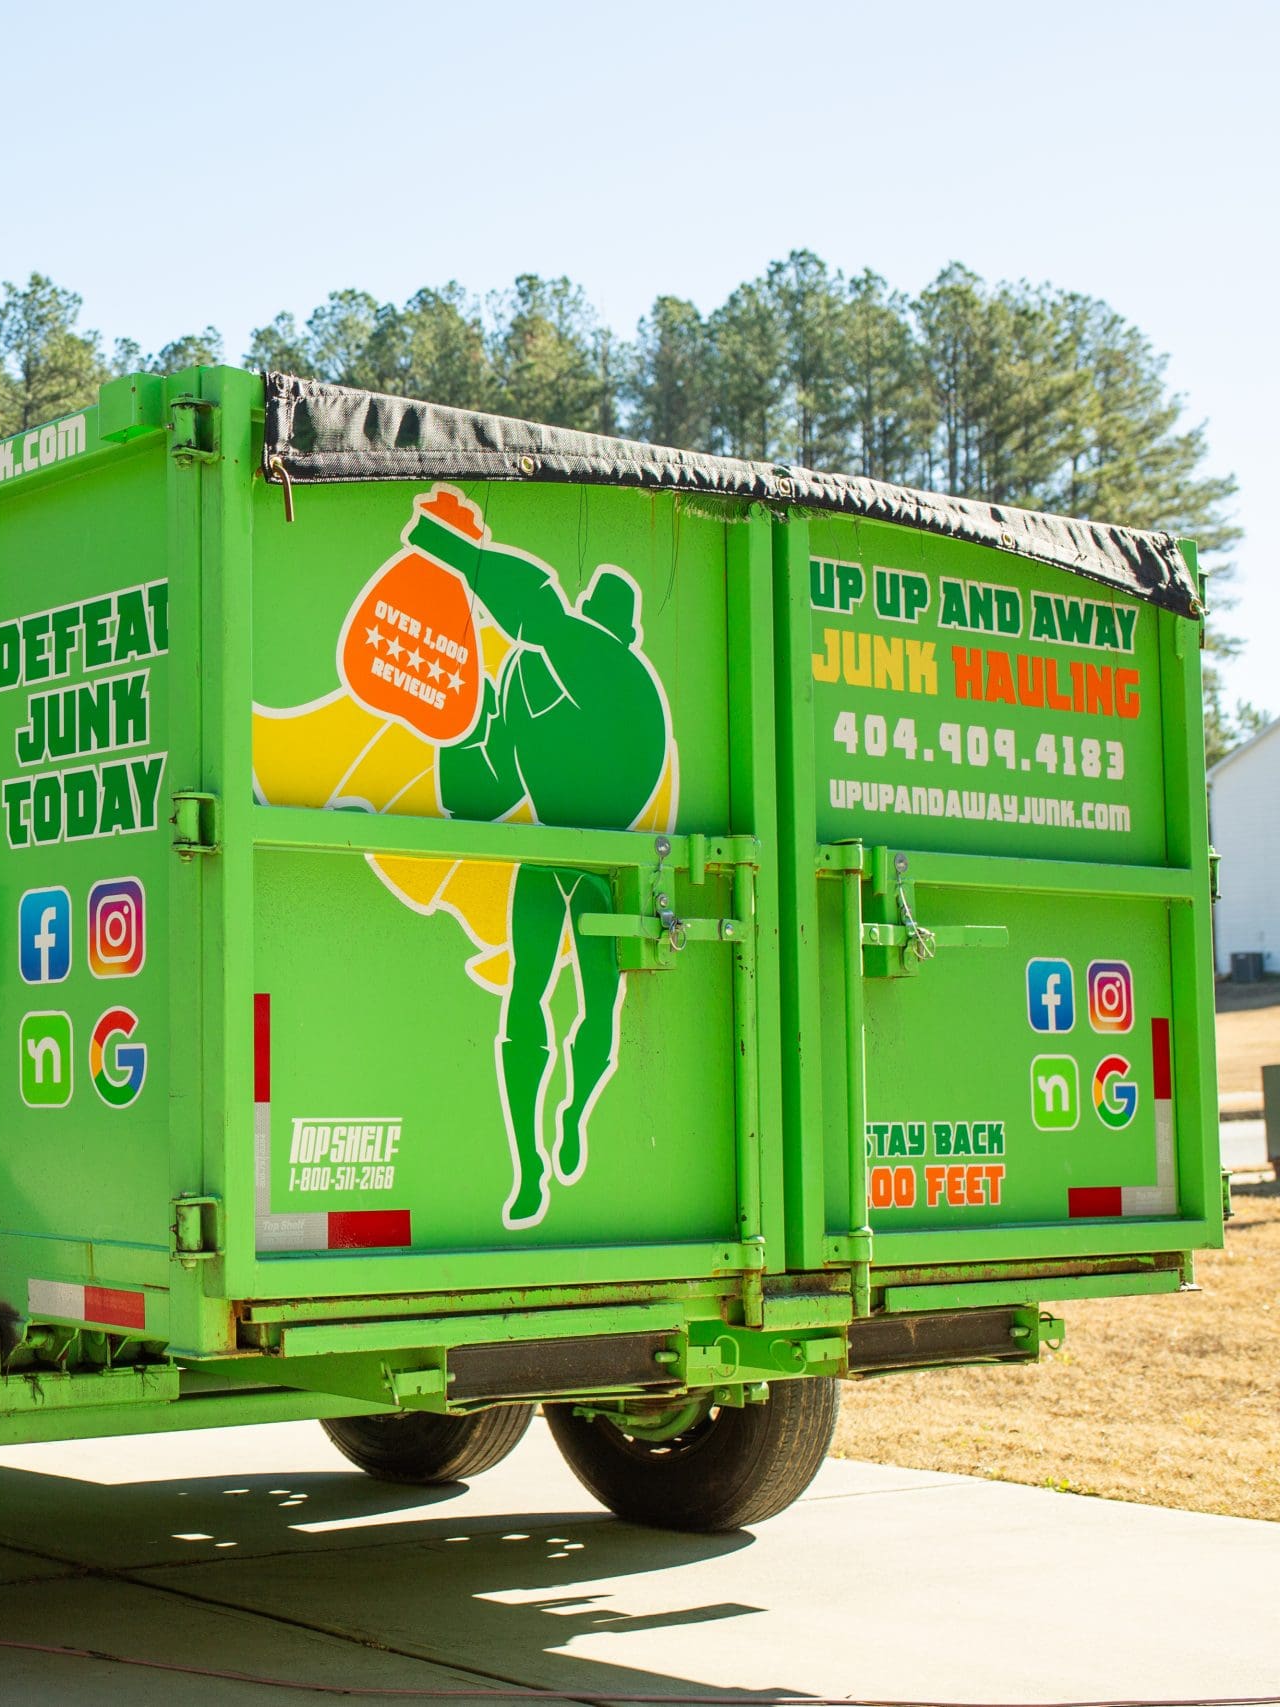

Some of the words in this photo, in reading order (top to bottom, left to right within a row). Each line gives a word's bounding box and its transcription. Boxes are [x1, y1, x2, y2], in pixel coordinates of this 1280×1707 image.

[374, 600, 422, 639] OVER
[423, 626, 469, 665] 1,000
[809, 555, 865, 615] UP
[873, 565, 930, 623] UP
[937, 575, 1023, 638] AND
[1029, 589, 1140, 655] AWAY
[371, 656, 447, 711] REVIEWS
[811, 628, 938, 695] JUNK
[952, 645, 1140, 719] HAULING
[15, 668, 150, 767] JUNK
[833, 711, 1126, 781] 404.909.4183
[1, 751, 168, 849] TODAY
[932, 1121, 1006, 1157] BACK
[288, 1166, 395, 1192] 1-800-511-2168
[925, 1164, 1006, 1208] FEET
